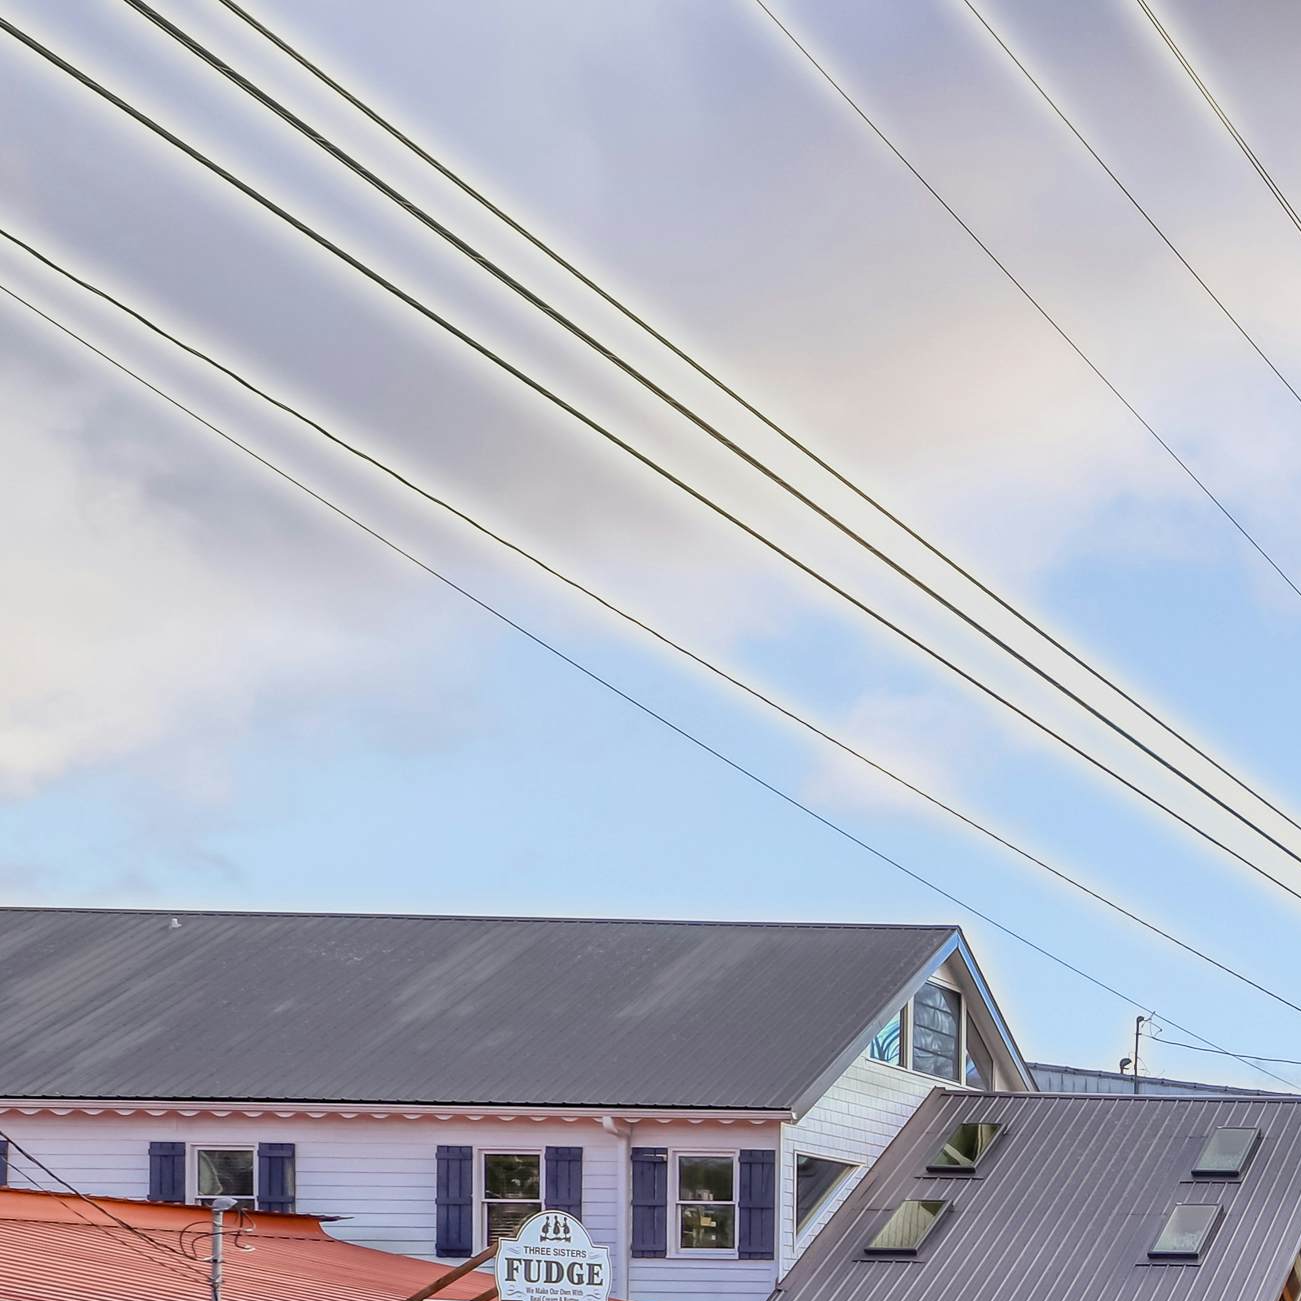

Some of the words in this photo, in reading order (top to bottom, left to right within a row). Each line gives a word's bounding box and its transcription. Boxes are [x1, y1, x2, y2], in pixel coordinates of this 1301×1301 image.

[523, 1246, 551, 1256] THREE
[553, 1247, 587, 1258] SISTERS
[504, 1257, 604, 1286] FUDGE
